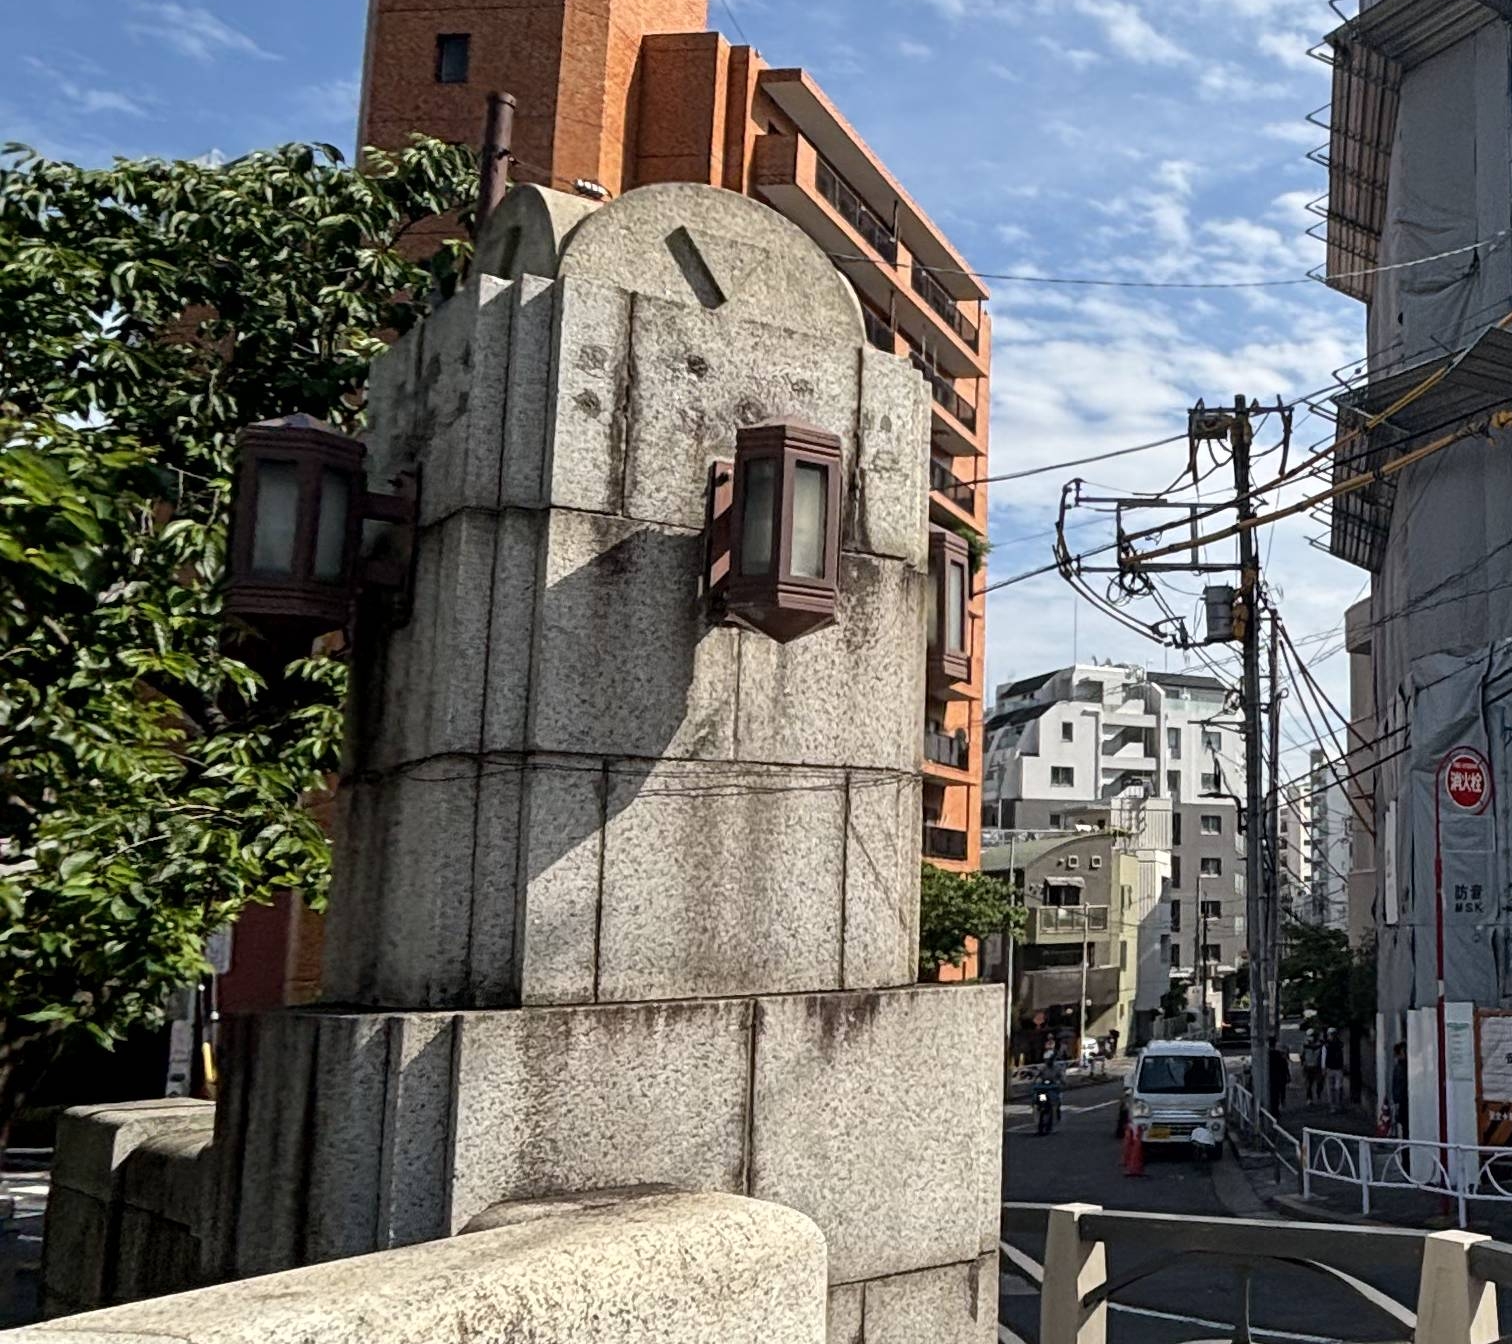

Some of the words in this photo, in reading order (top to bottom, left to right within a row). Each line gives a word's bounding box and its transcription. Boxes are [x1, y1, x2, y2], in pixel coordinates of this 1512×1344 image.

[1450, 771, 1483, 793] 消火栓
[1454, 884, 1484, 901] 防音
[1454, 902, 1484, 914] MSK
